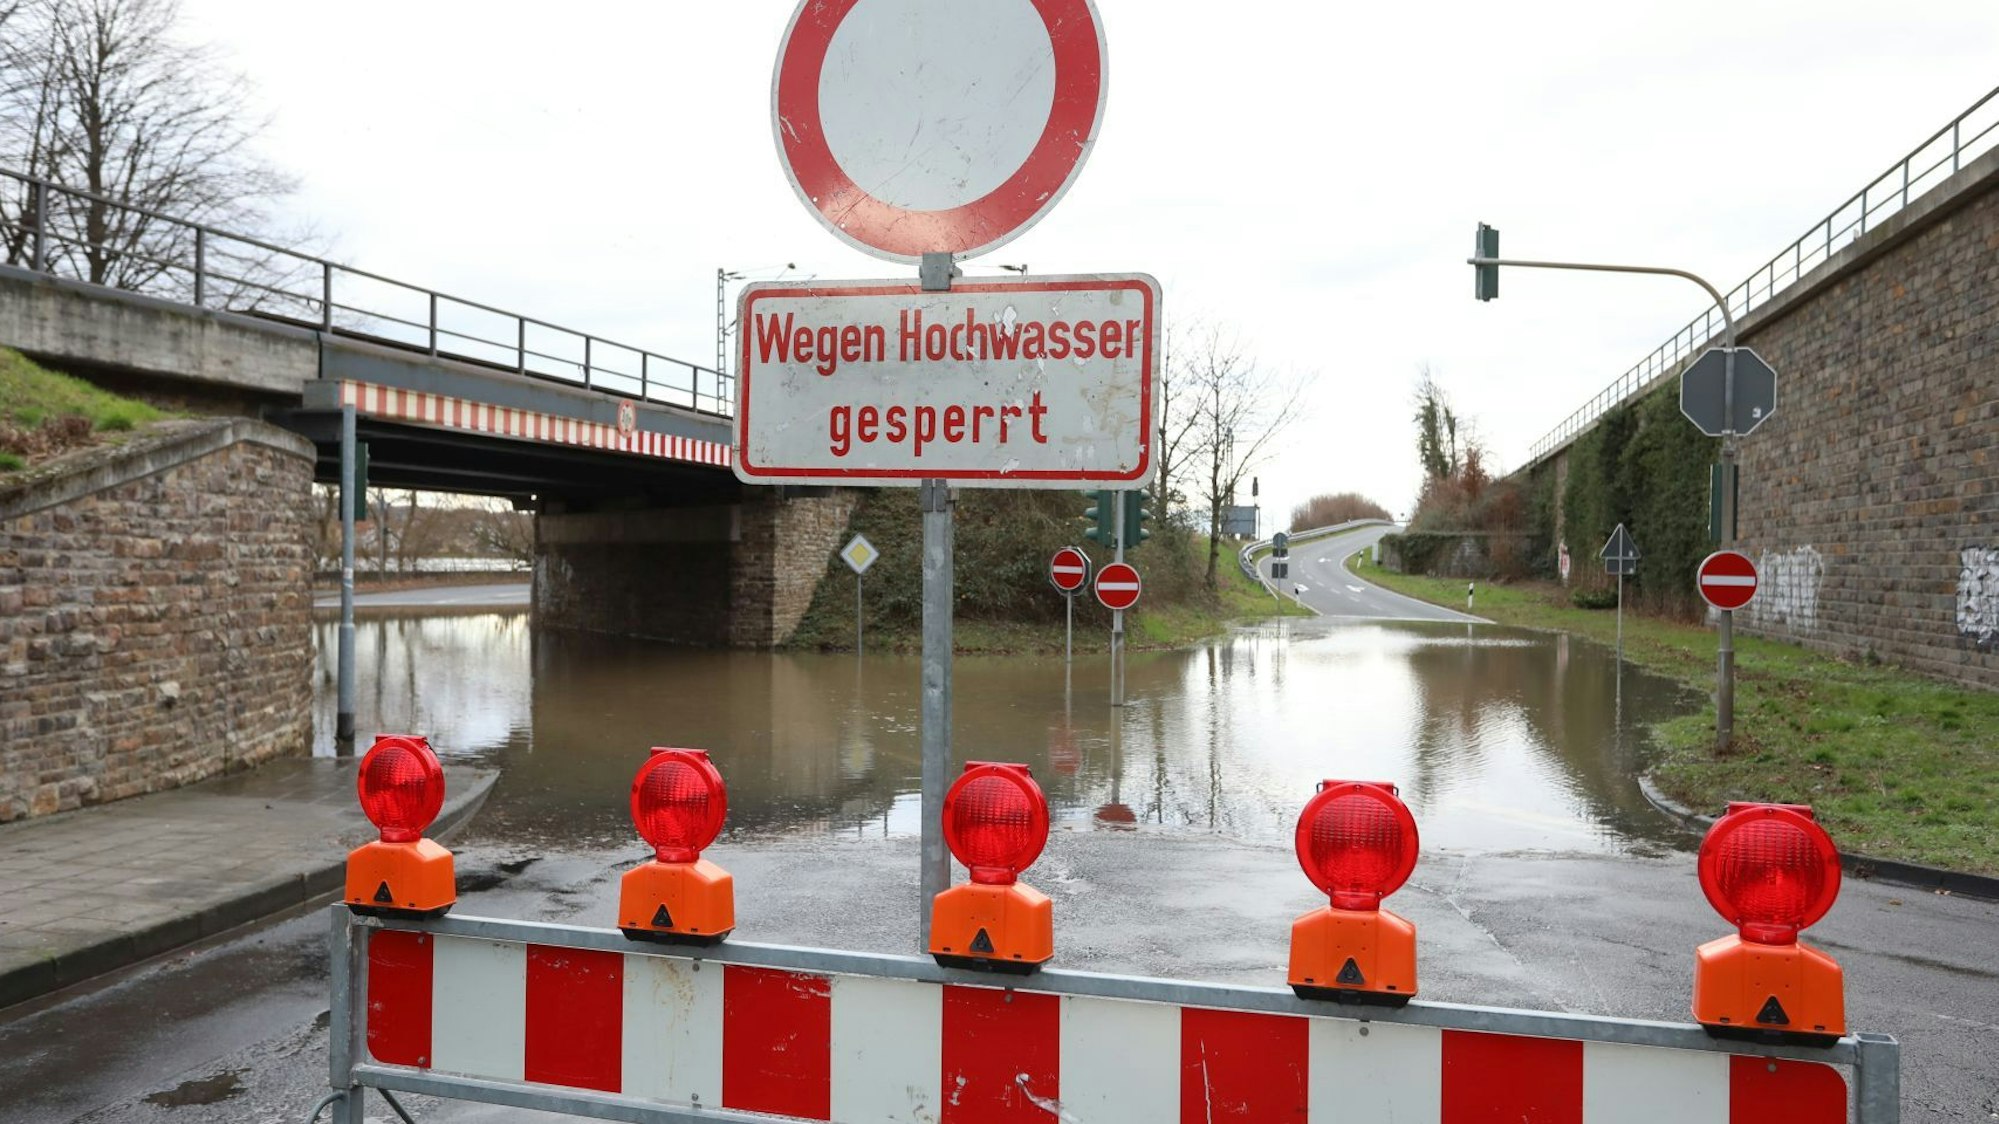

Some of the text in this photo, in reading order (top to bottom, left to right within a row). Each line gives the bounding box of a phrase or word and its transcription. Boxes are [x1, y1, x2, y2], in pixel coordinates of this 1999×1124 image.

[756, 308, 1141, 377] Wegen Hochwasser
[830, 390, 1048, 457] gesperrt
